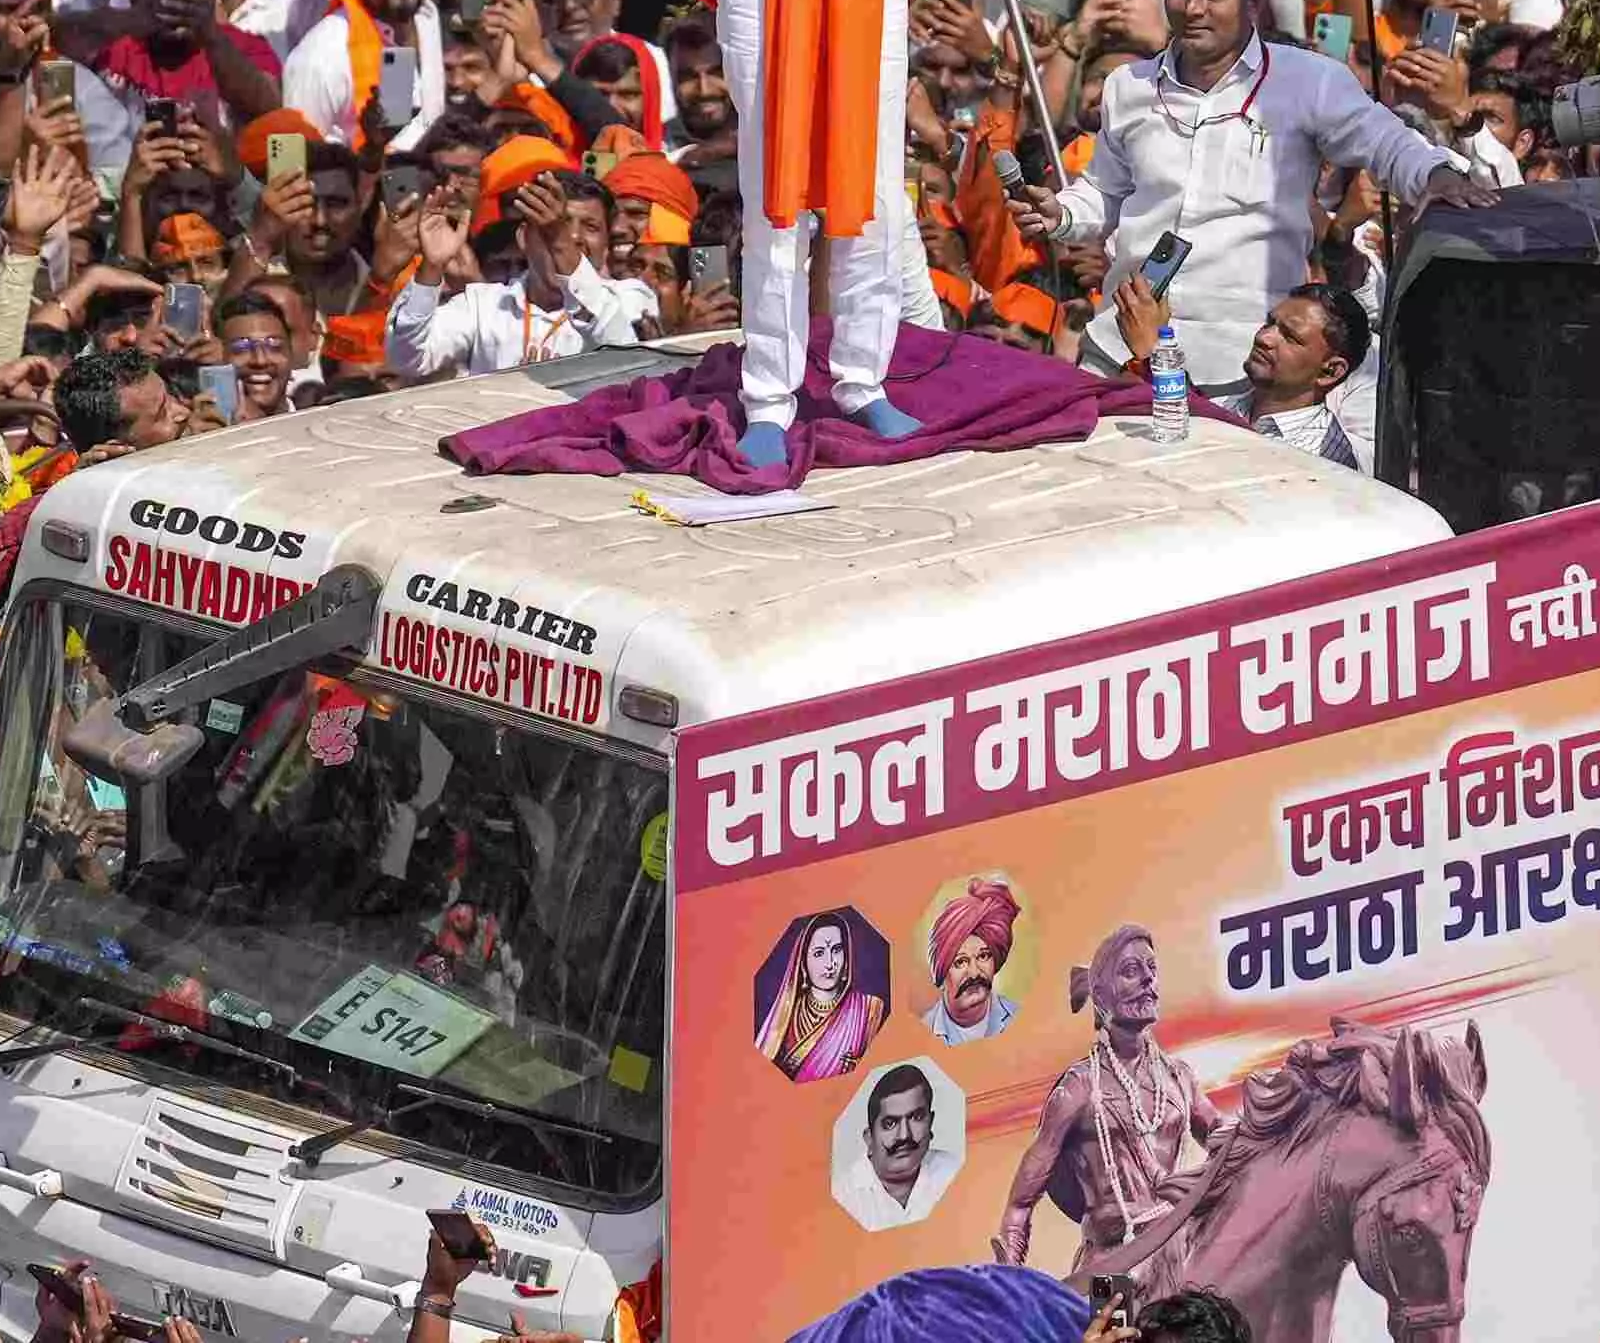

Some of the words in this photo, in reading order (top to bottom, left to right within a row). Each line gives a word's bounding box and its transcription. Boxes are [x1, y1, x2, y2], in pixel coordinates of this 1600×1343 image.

[130, 499, 307, 559] GOODS
[380, 610, 501, 699] LOGISTICS
[405, 573, 599, 655] CARRIER
[697, 695, 953, 865] सकल
[963, 629, 1219, 793] मराठा
[1230, 559, 1498, 734] समाज
[1507, 569, 1597, 649] नवी
[1282, 771, 1431, 877] एकच
[1219, 869, 1425, 991] मराठा
[360, 1007, 449, 1057] S147
[471, 1190, 509, 1215] KAMAL
[512, 1200, 559, 1229] MOTORS
[152, 1279, 240, 1338] TATA
